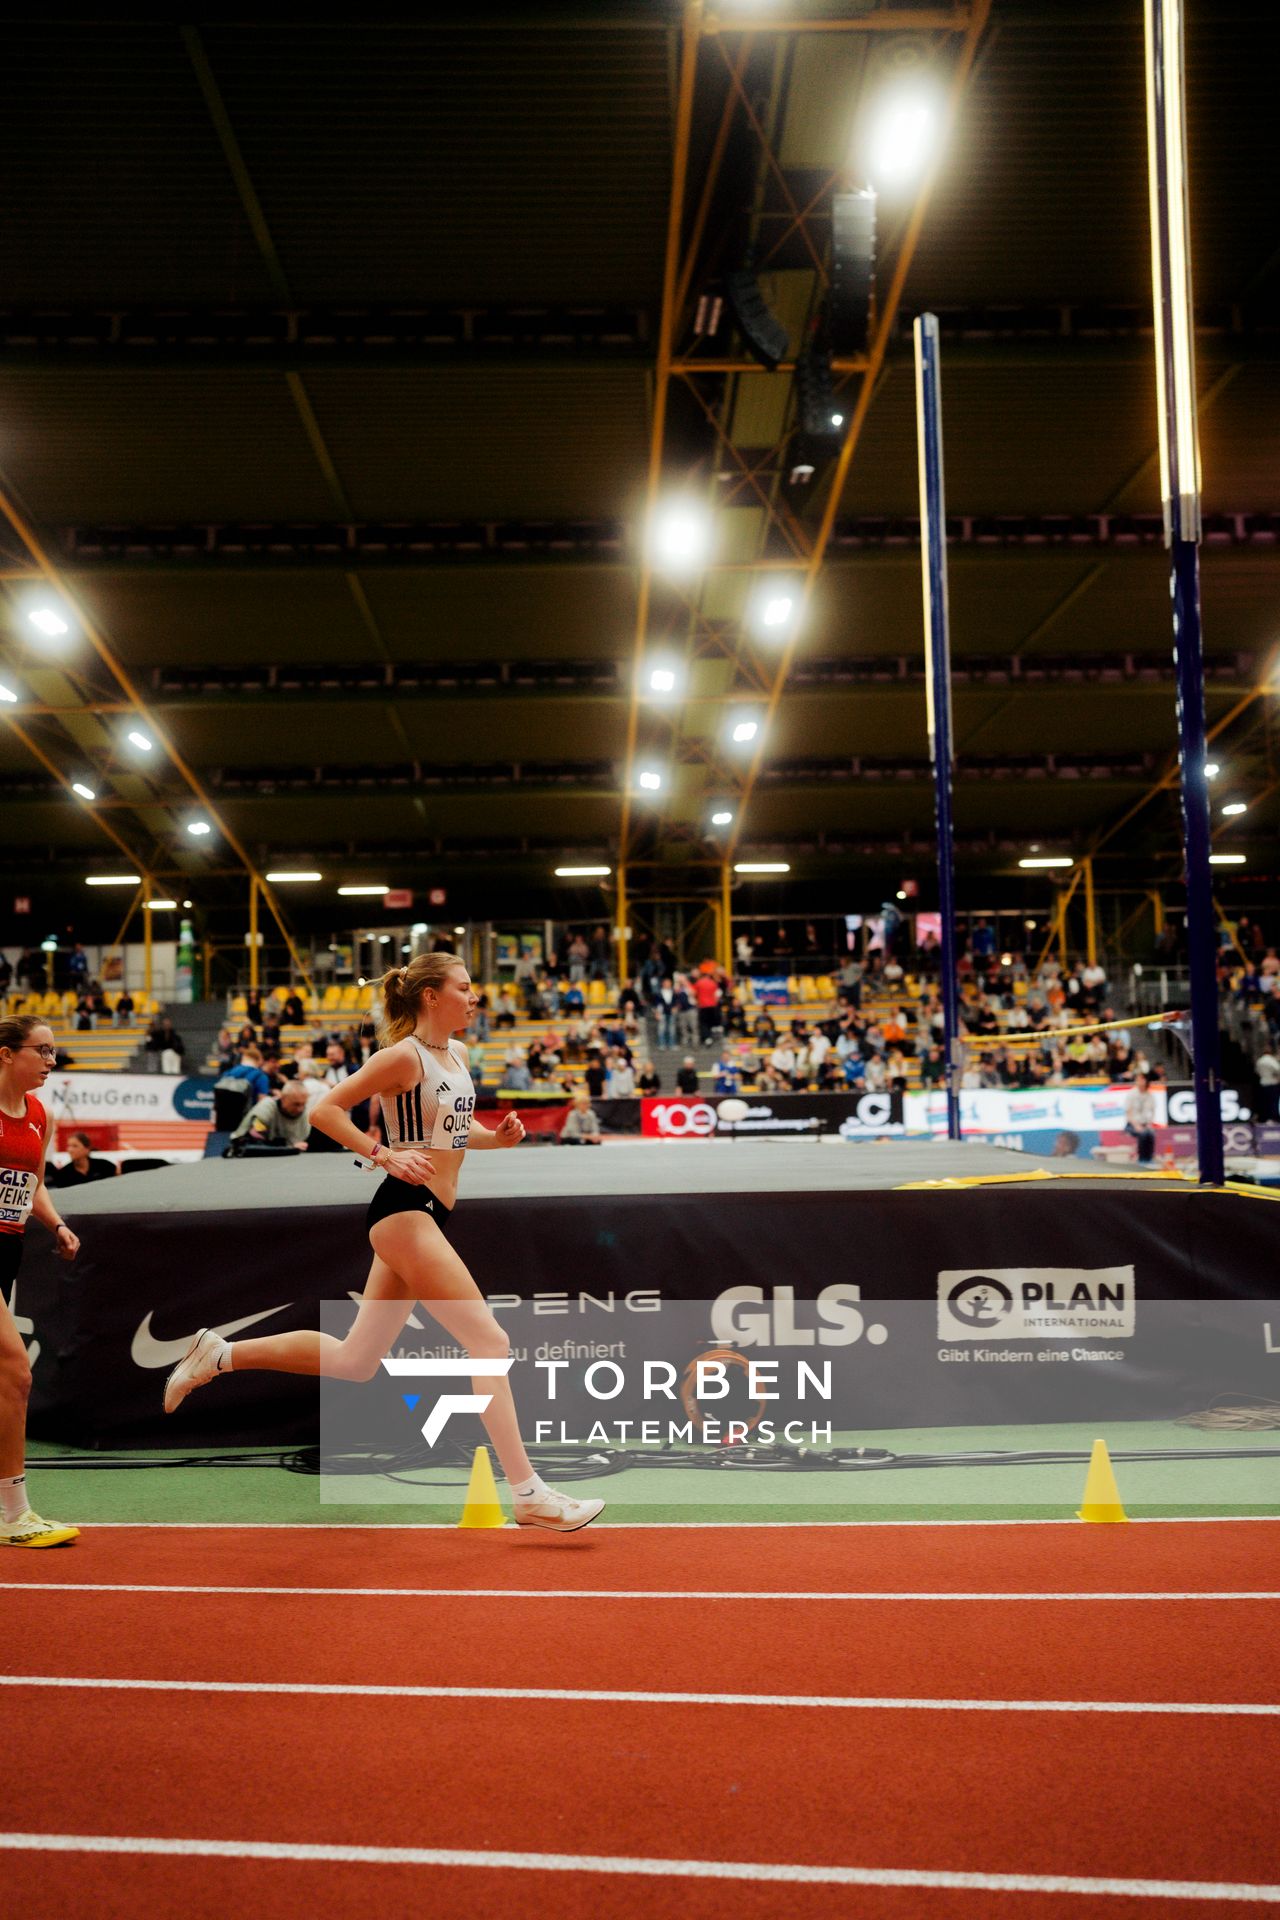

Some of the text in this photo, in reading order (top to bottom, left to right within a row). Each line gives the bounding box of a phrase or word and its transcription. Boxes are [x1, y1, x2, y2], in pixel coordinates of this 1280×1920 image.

[52, 1089, 159, 1106] NatuGena
[1168, 1090, 1251, 1123] GS.
[1022, 1282, 1125, 1311] PLAN
[711, 1284, 888, 1347] GLS.
[1023, 1318, 1125, 1328] INTERNATIONAL
[534, 1340, 627, 1361] definiert
[937, 1348, 1125, 1362] Gibt Kindern eine Chance
